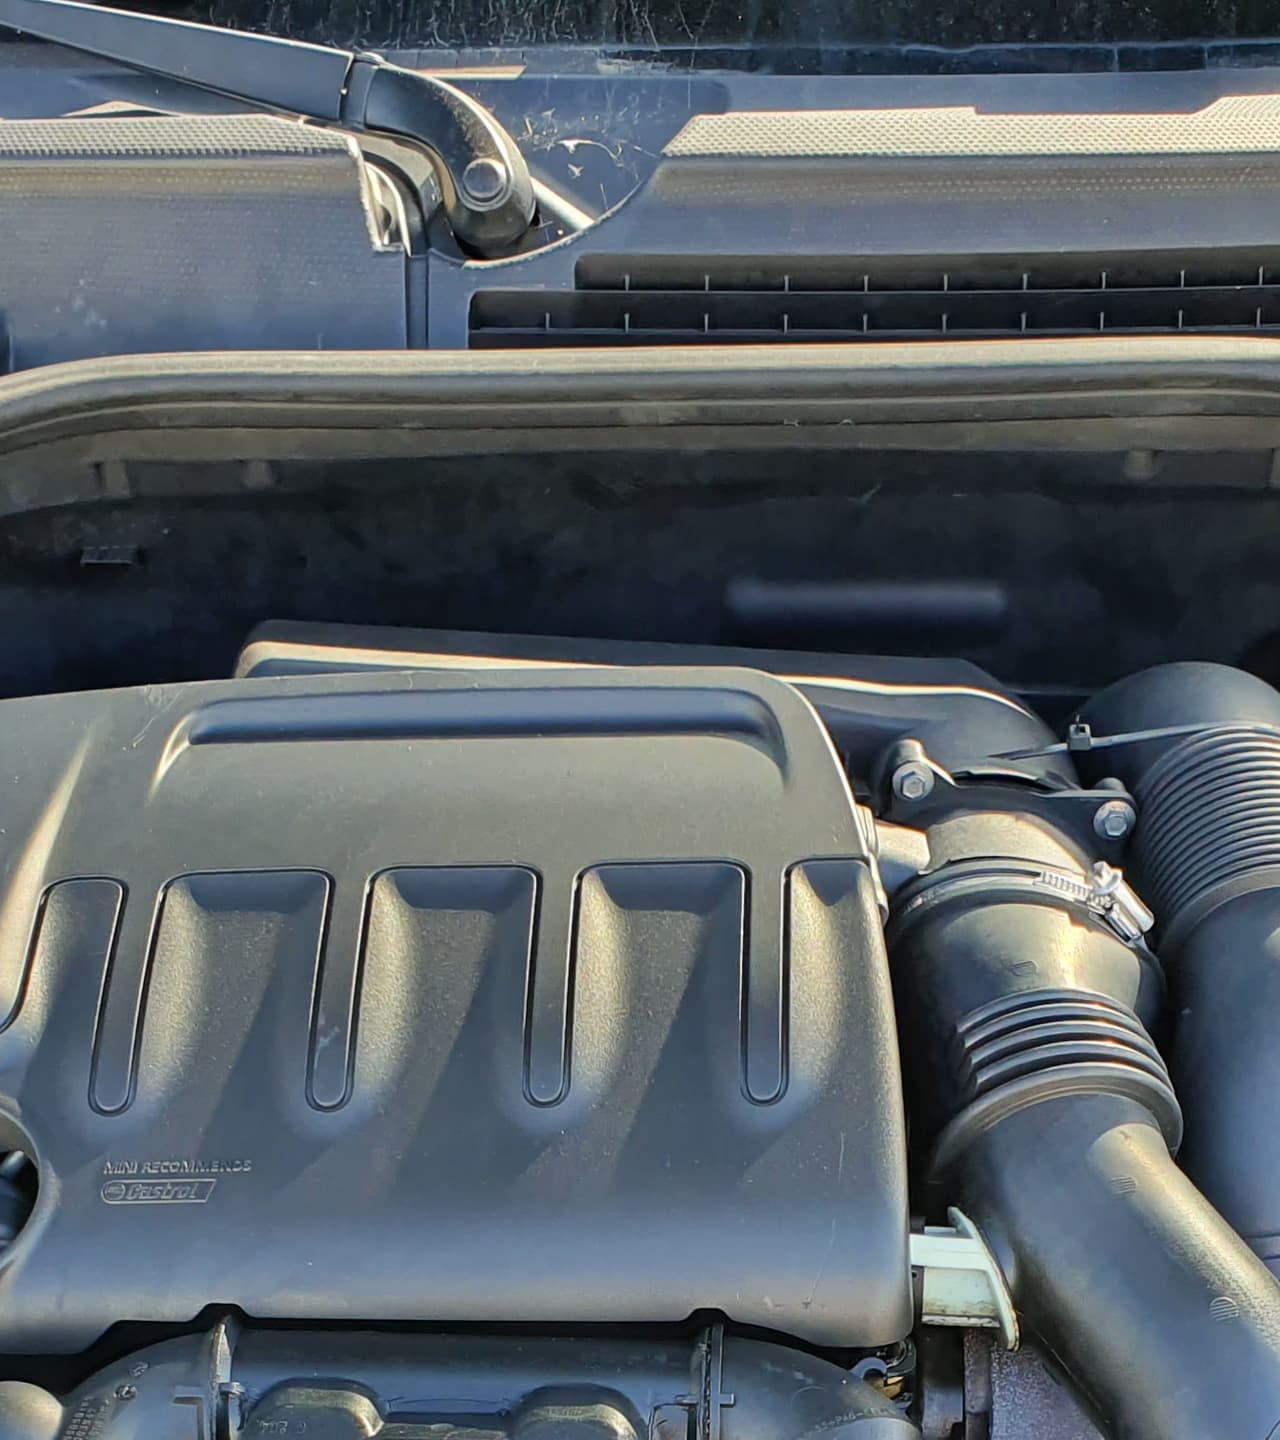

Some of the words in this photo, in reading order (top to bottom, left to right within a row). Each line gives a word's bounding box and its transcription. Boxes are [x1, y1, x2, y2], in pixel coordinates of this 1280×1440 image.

[103, 1161, 138, 1175] MINI
[141, 1159, 253, 1174] RECOMMENDS
[126, 1182, 199, 1201] Castrol
